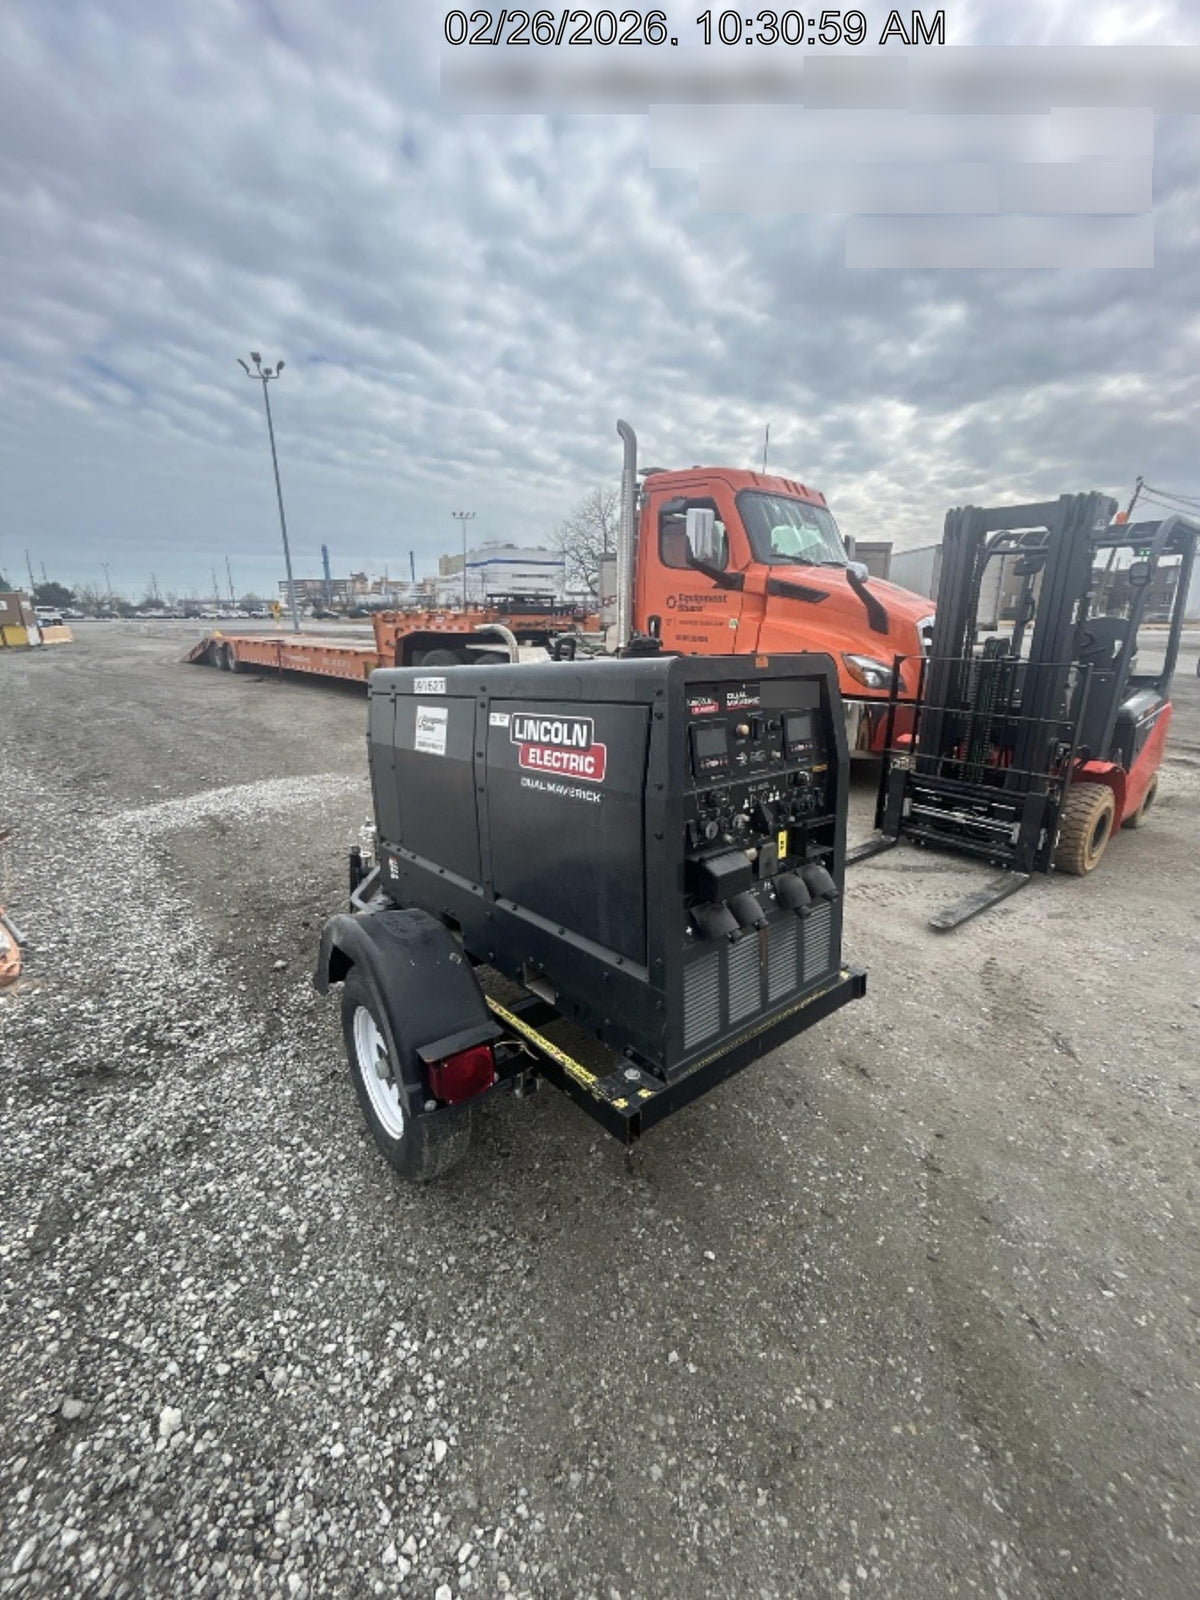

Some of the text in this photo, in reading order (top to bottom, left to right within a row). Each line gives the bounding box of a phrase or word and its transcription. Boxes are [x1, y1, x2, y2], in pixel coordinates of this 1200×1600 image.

[679, 594, 728, 605] Equipment
[514, 718, 588, 748] LINCOLN
[527, 747, 595, 775] ELECTRIC
[520, 776, 602, 803] DUAL MAVERICK
